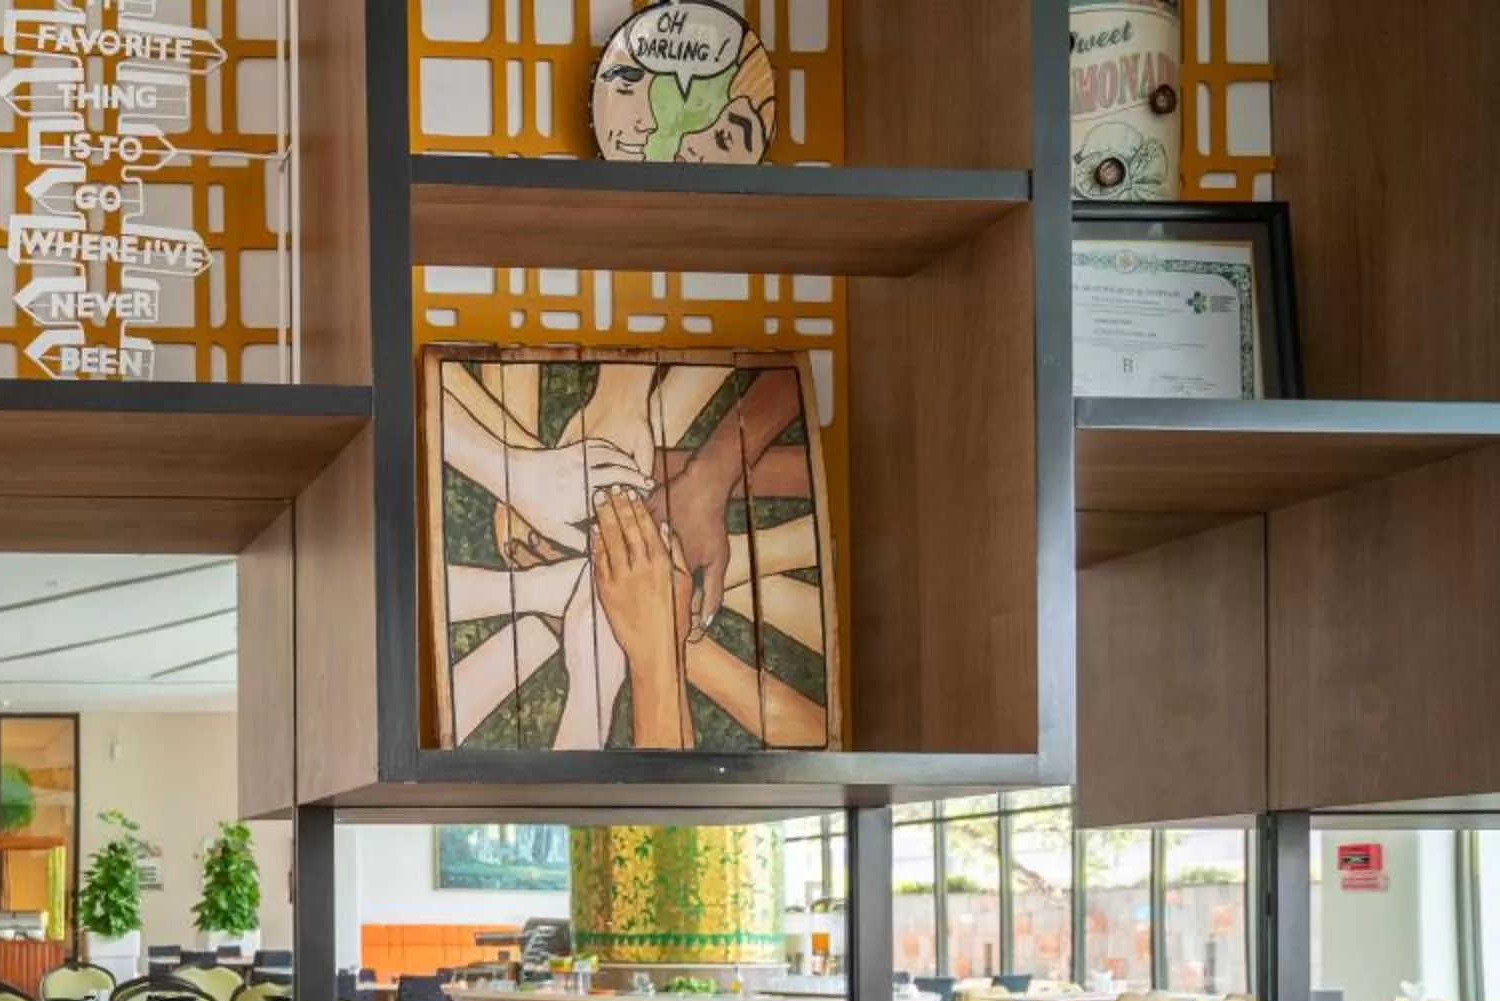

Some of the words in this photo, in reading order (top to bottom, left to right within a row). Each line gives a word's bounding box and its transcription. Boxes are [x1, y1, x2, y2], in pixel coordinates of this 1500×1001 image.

[657, 11, 688, 34] OH
[37, 24, 192, 62] FAVORITE
[57, 83, 157, 109] THING
[64, 134, 92, 159] IS
[99, 136, 143, 162] TO
[75, 185, 122, 212] GO
[20, 228, 137, 263] WHERE
[142, 239, 204, 269] I'VE
[50, 291, 154, 318] NEVER
[60, 347, 143, 376] BEEN
